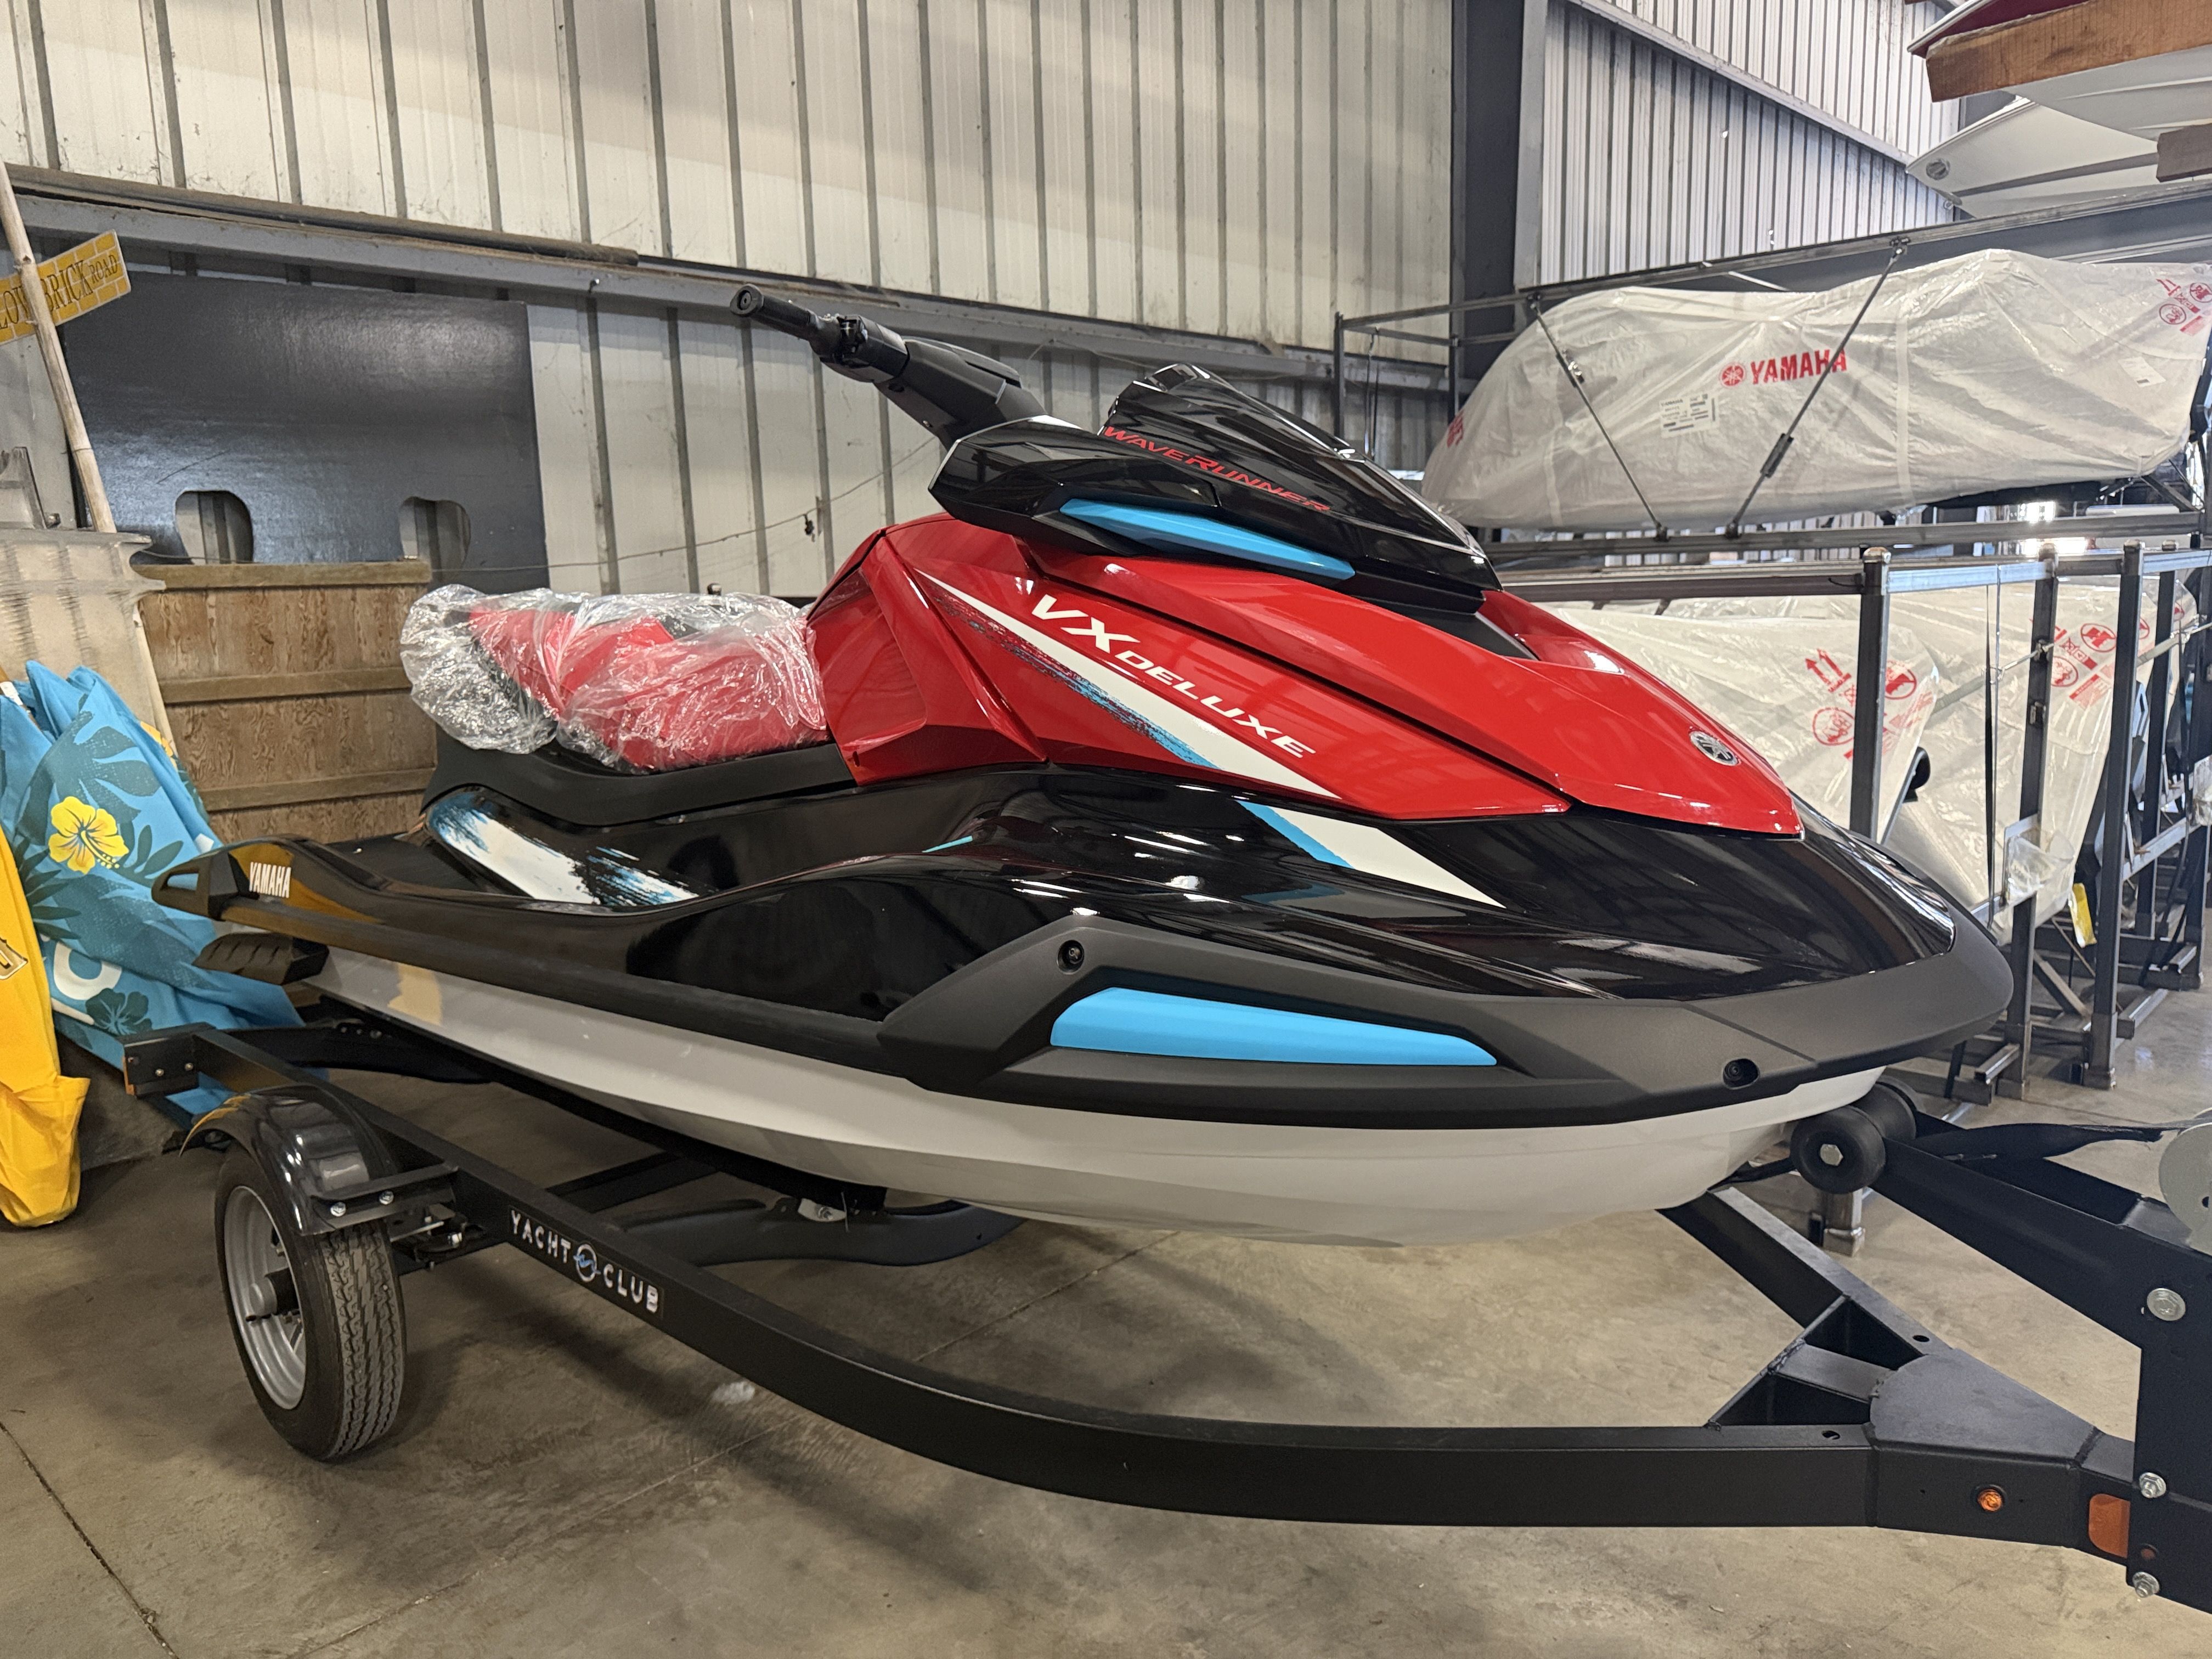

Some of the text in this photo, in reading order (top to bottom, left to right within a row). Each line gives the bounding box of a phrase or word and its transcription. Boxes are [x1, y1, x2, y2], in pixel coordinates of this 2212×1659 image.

[41, 260, 93, 312] BRICK
[88, 255, 118, 284] ROAD
[1751, 347, 1847, 385] YAMAHA
[1104, 426, 1331, 511] WAVERUNNER
[1115, 650, 1316, 758] DELUXE
[249, 861, 292, 899] YAMAHA
[511, 1210, 658, 1313] YACHT CLUB
